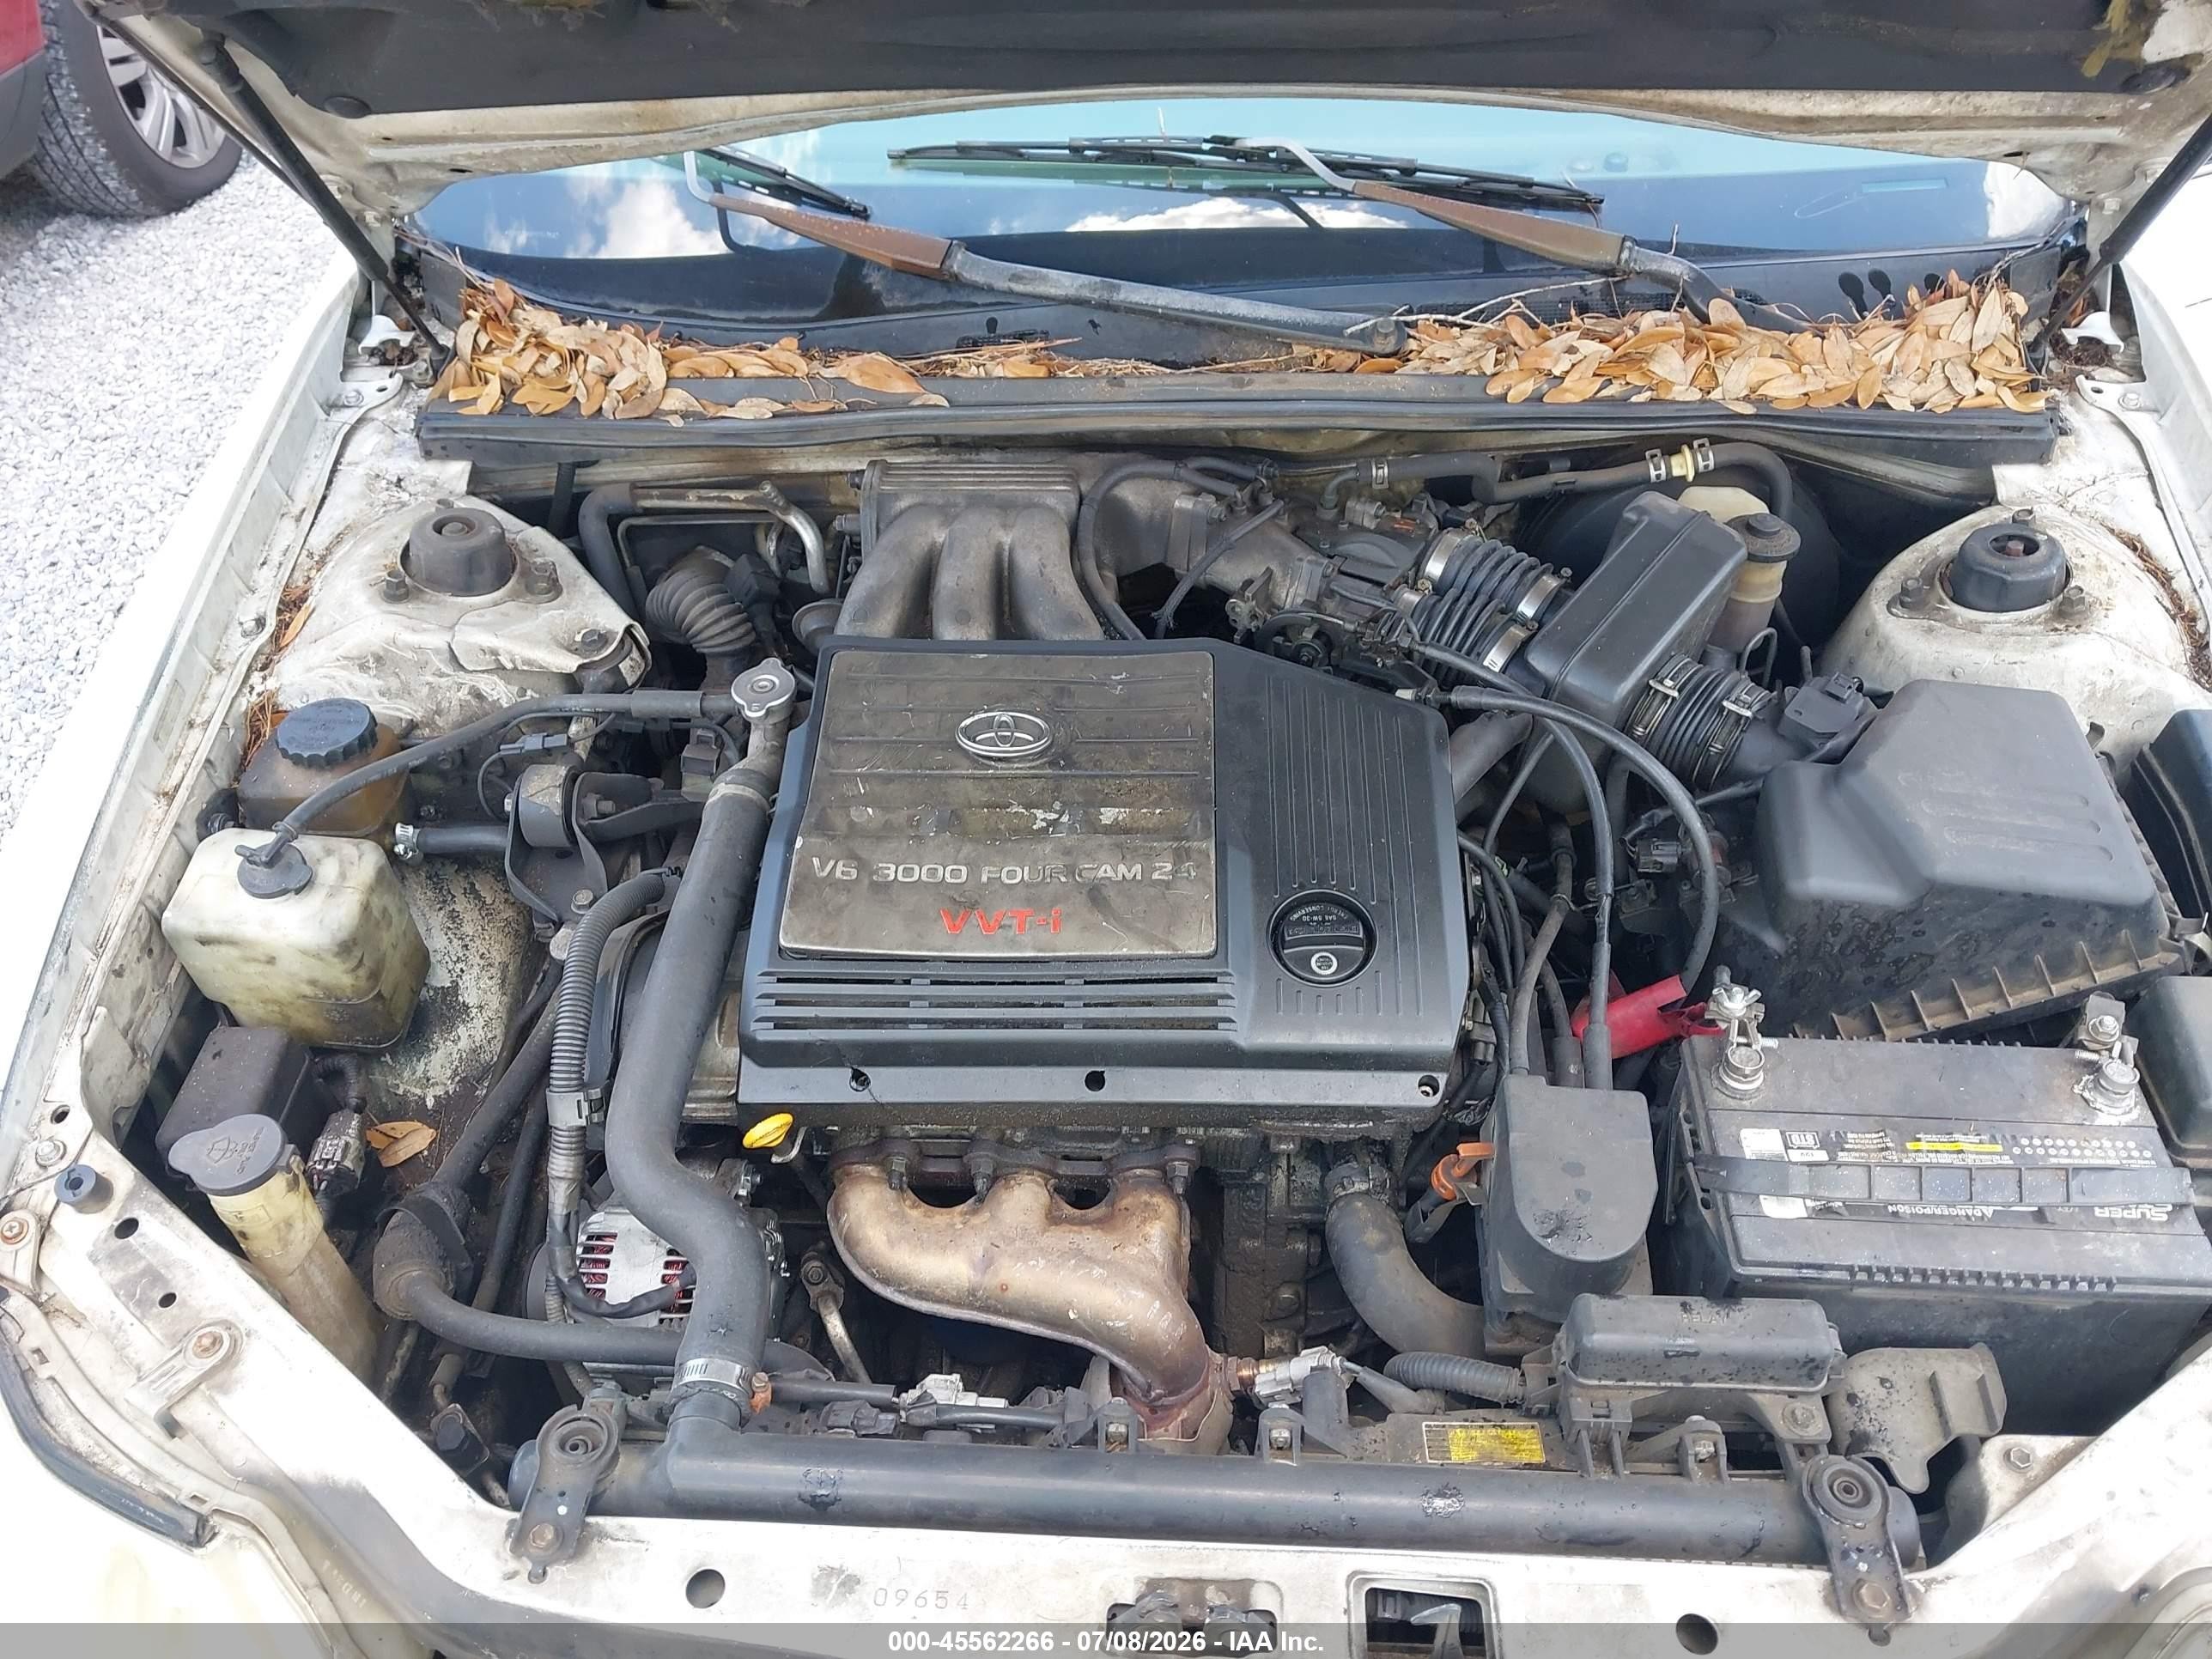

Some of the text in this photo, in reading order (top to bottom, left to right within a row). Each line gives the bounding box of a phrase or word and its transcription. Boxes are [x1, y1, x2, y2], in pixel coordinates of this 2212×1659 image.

[811, 857, 1197, 885] V6 3000 FOUR CAM 24
[939, 907, 1062, 935] VVT-i
[2094, 1206, 2169, 1222] SUPER
[872, 1587, 969, 1610] 09654
